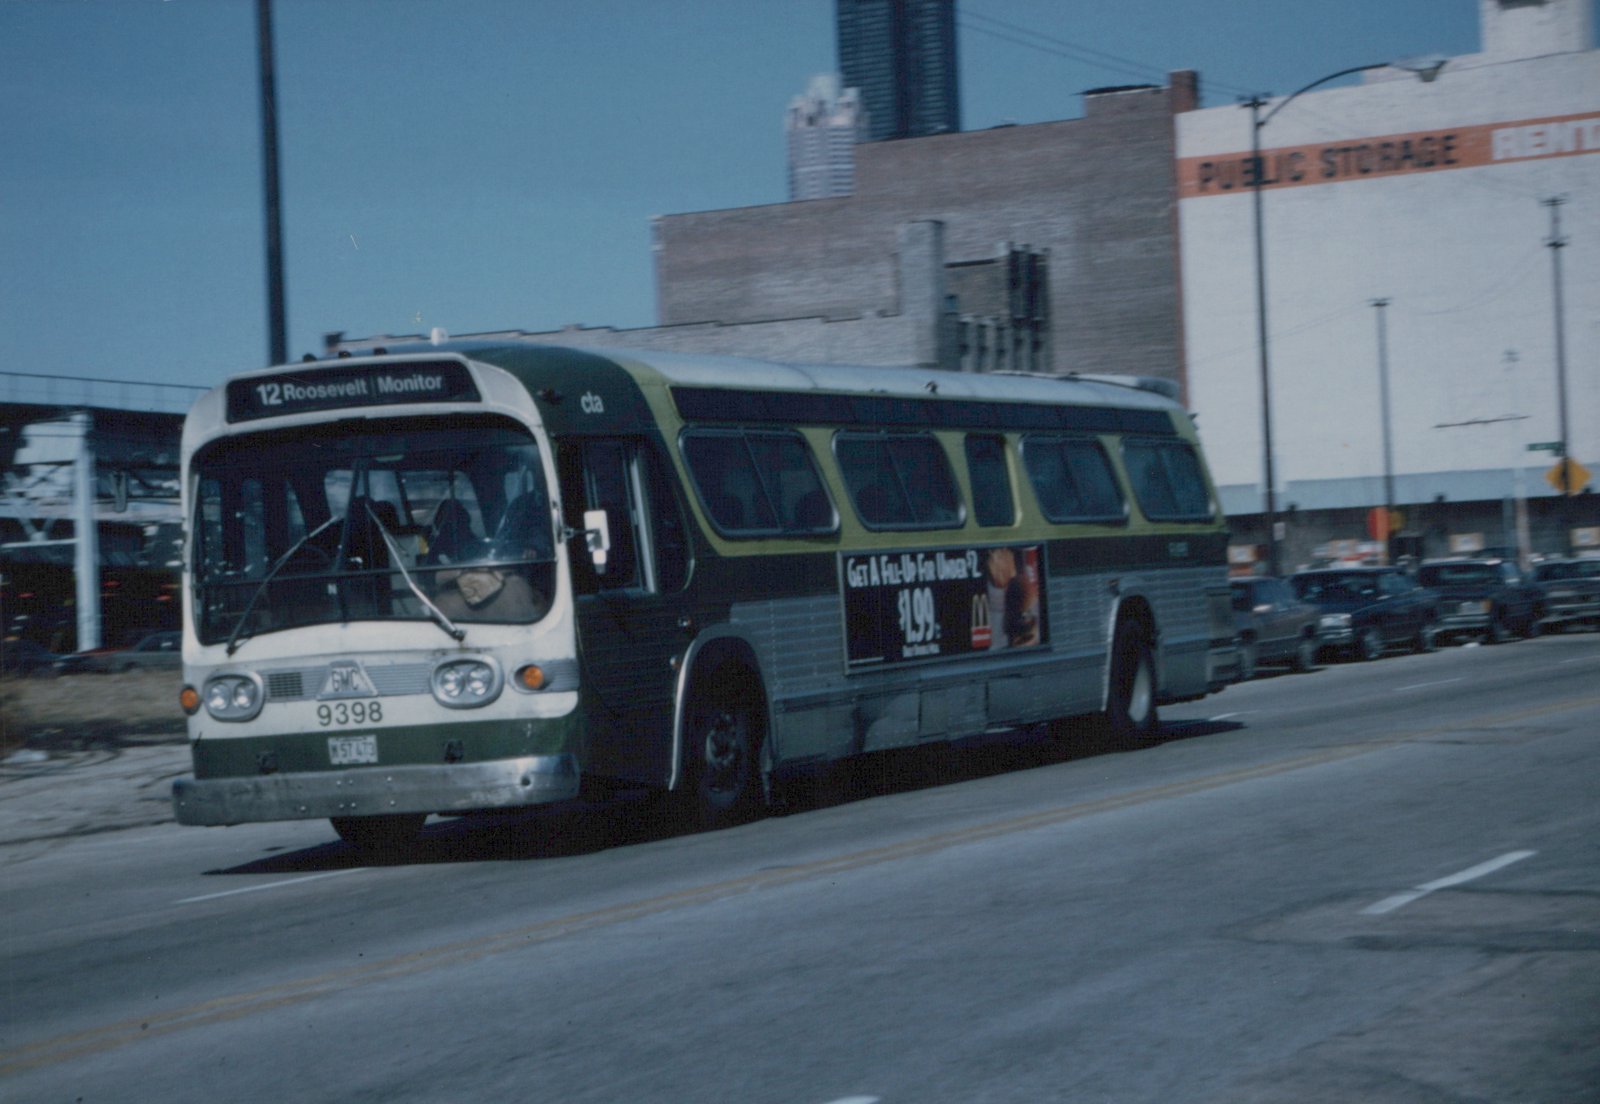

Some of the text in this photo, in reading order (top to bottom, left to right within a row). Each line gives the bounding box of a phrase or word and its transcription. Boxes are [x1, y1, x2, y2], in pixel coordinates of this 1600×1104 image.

[1319, 134, 1458, 179] STORAGE
[257, 375, 443, 405] 12 Roosevelt Monitor
[580, 391, 604, 414] cta
[331, 669, 359, 692] GMC
[316, 701, 383, 727] 9398
